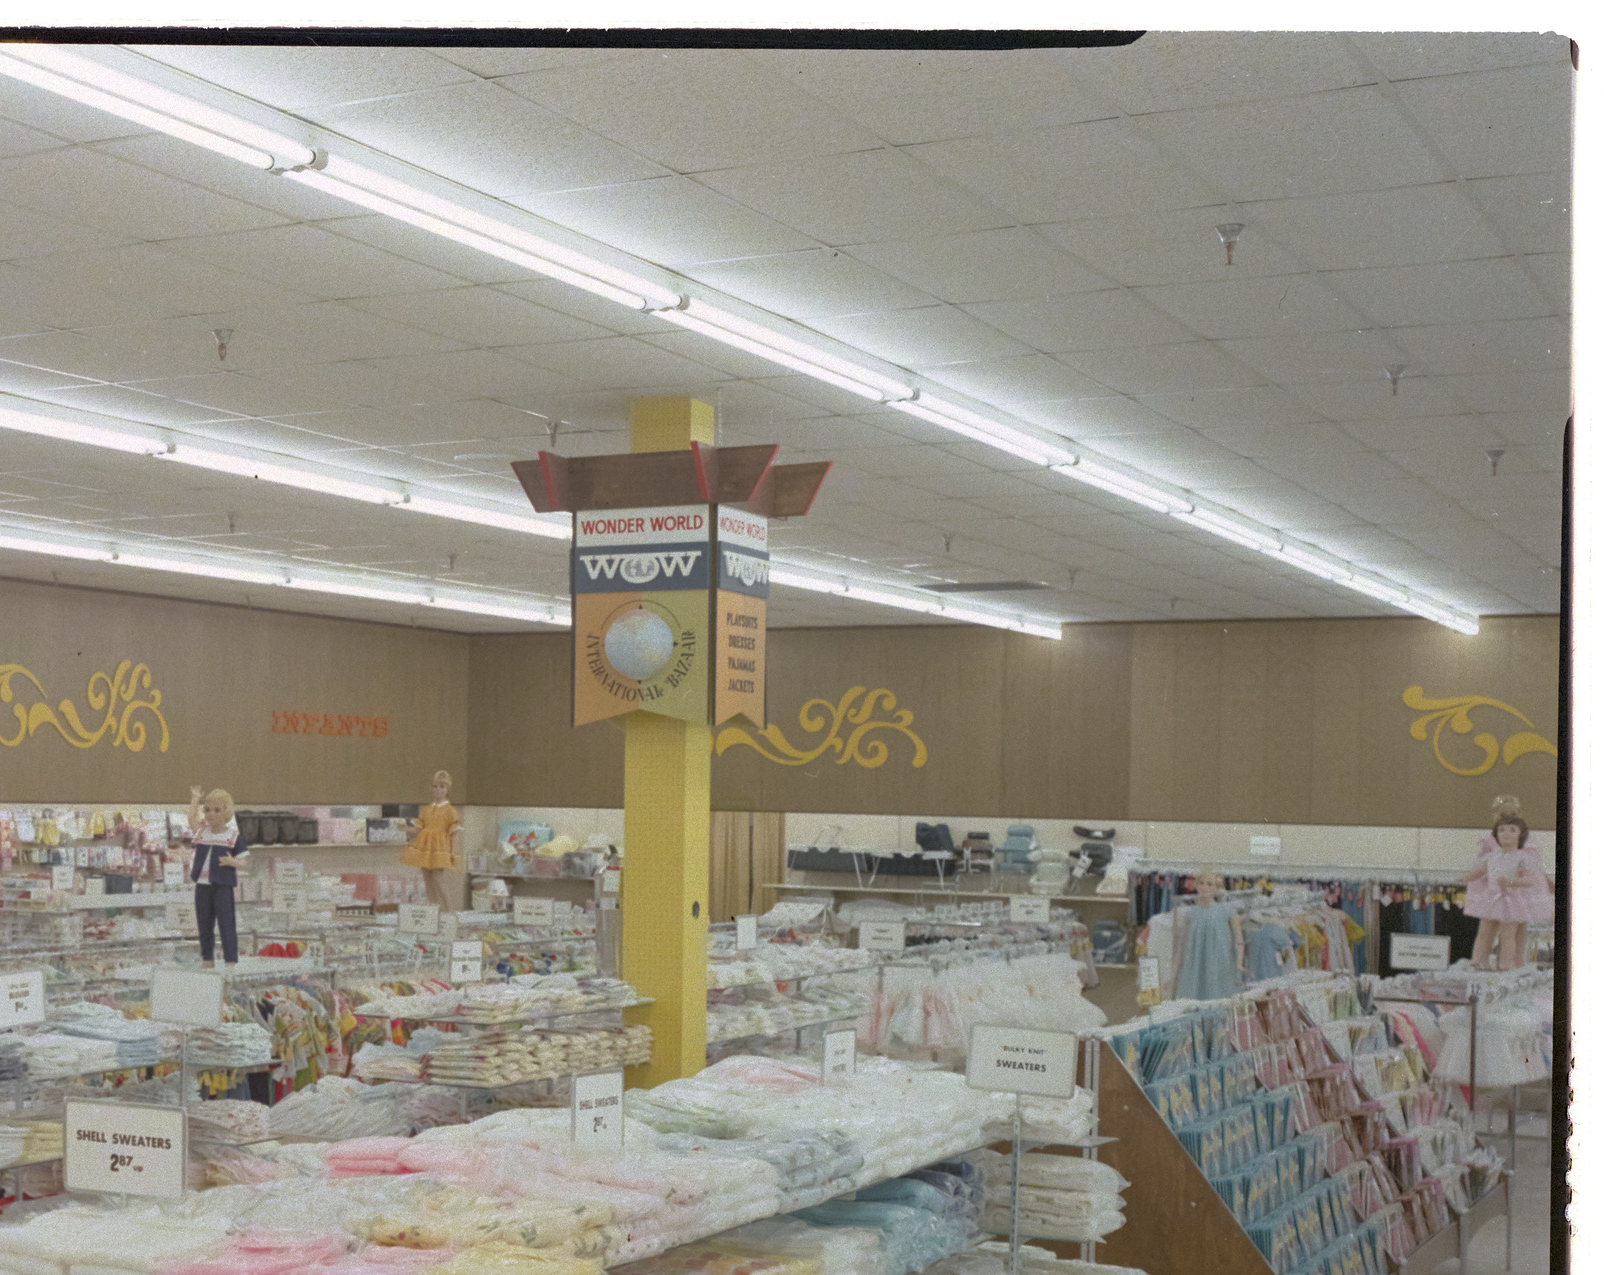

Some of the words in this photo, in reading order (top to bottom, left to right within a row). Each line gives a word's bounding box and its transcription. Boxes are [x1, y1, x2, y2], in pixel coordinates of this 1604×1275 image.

[580, 517, 645, 535] WONDER
[650, 515, 704, 531] WORLD
[719, 516, 746, 536] WONDER
[747, 522, 767, 542] WORLD
[586, 633, 665, 702] INTERNATIONAL
[664, 630, 696, 689] BAZAAR
[727, 678, 755, 694] JACKETS
[271, 710, 390, 738] INFANTS
[995, 1058, 1047, 1073] SWEATERS
[76, 1129, 107, 1143] SHELL
[112, 1133, 172, 1150] SWEATERS
[109, 1153, 134, 1172] 287
